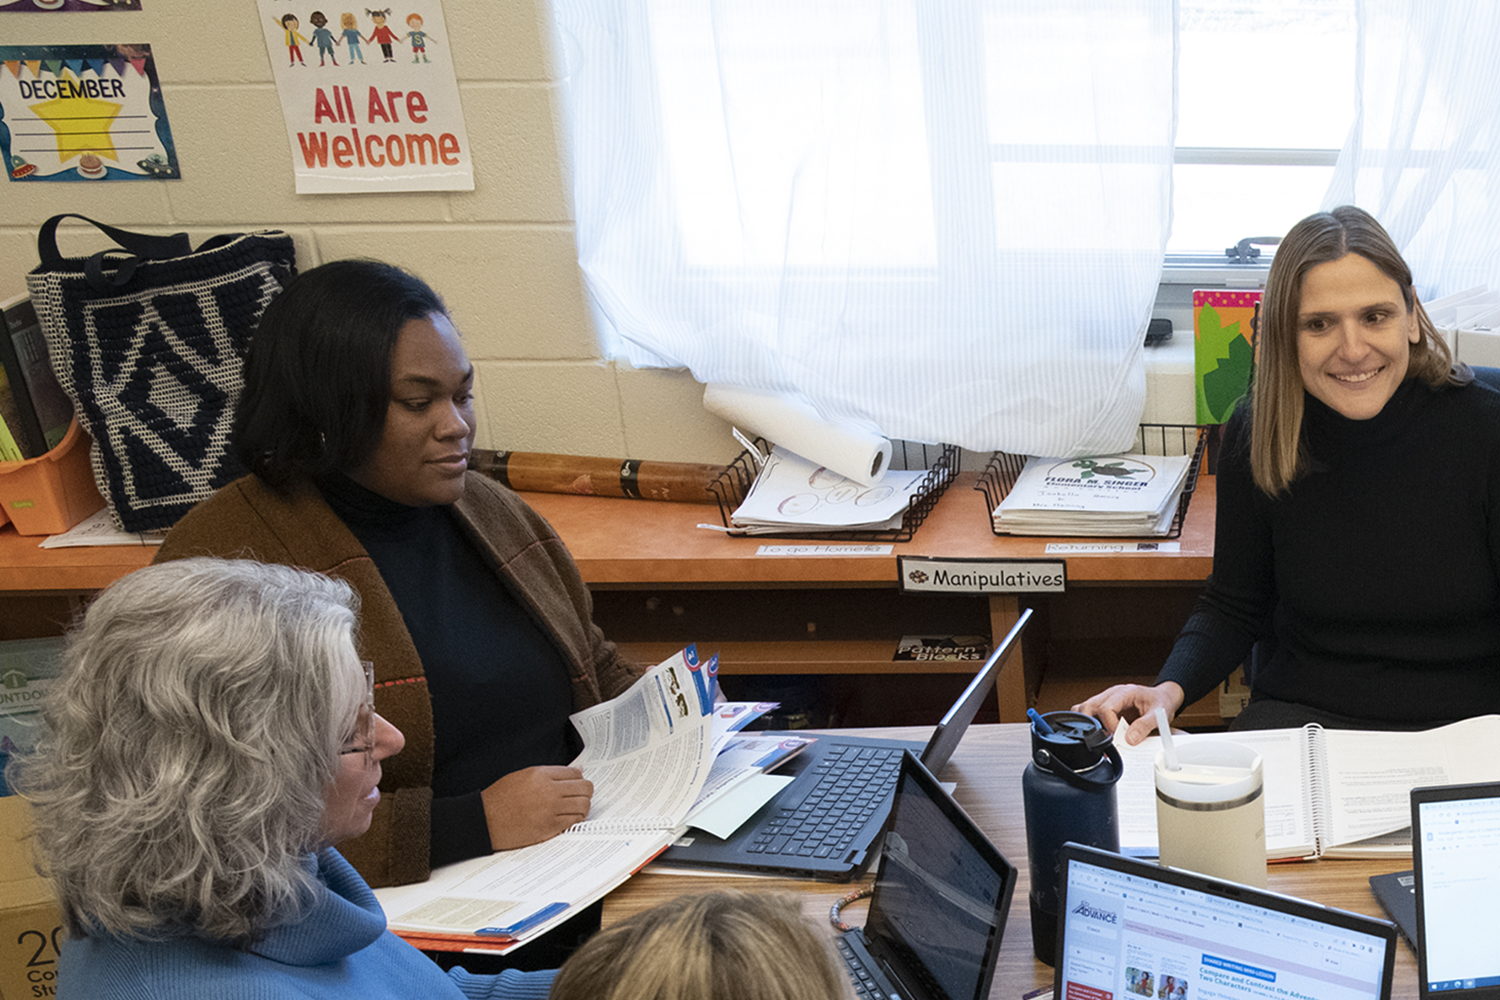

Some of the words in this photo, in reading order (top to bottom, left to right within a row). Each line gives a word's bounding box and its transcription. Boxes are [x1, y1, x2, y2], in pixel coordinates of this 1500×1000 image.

[18, 79, 126, 100] DECEMBER
[314, 85, 356, 125] All
[367, 89, 429, 125] Are
[297, 129, 461, 169] Welcome
[786, 547, 808, 556] go
[814, 545, 865, 553] Home
[1047, 544, 1124, 552] Returning
[933, 570, 1063, 590] Manipulatives
[897, 647, 976, 655] Pattern
[915, 651, 980, 661] Blocks
[1071, 903, 1117, 924] ADVANCE
[1198, 973, 1213, 982] Two
[1214, 977, 1251, 993] Characters
[1199, 966, 1229, 980] Compare
[1231, 974, 1244, 984] and
[1244, 978, 1275, 992] Contrast
[1276, 987, 1288, 996] the
